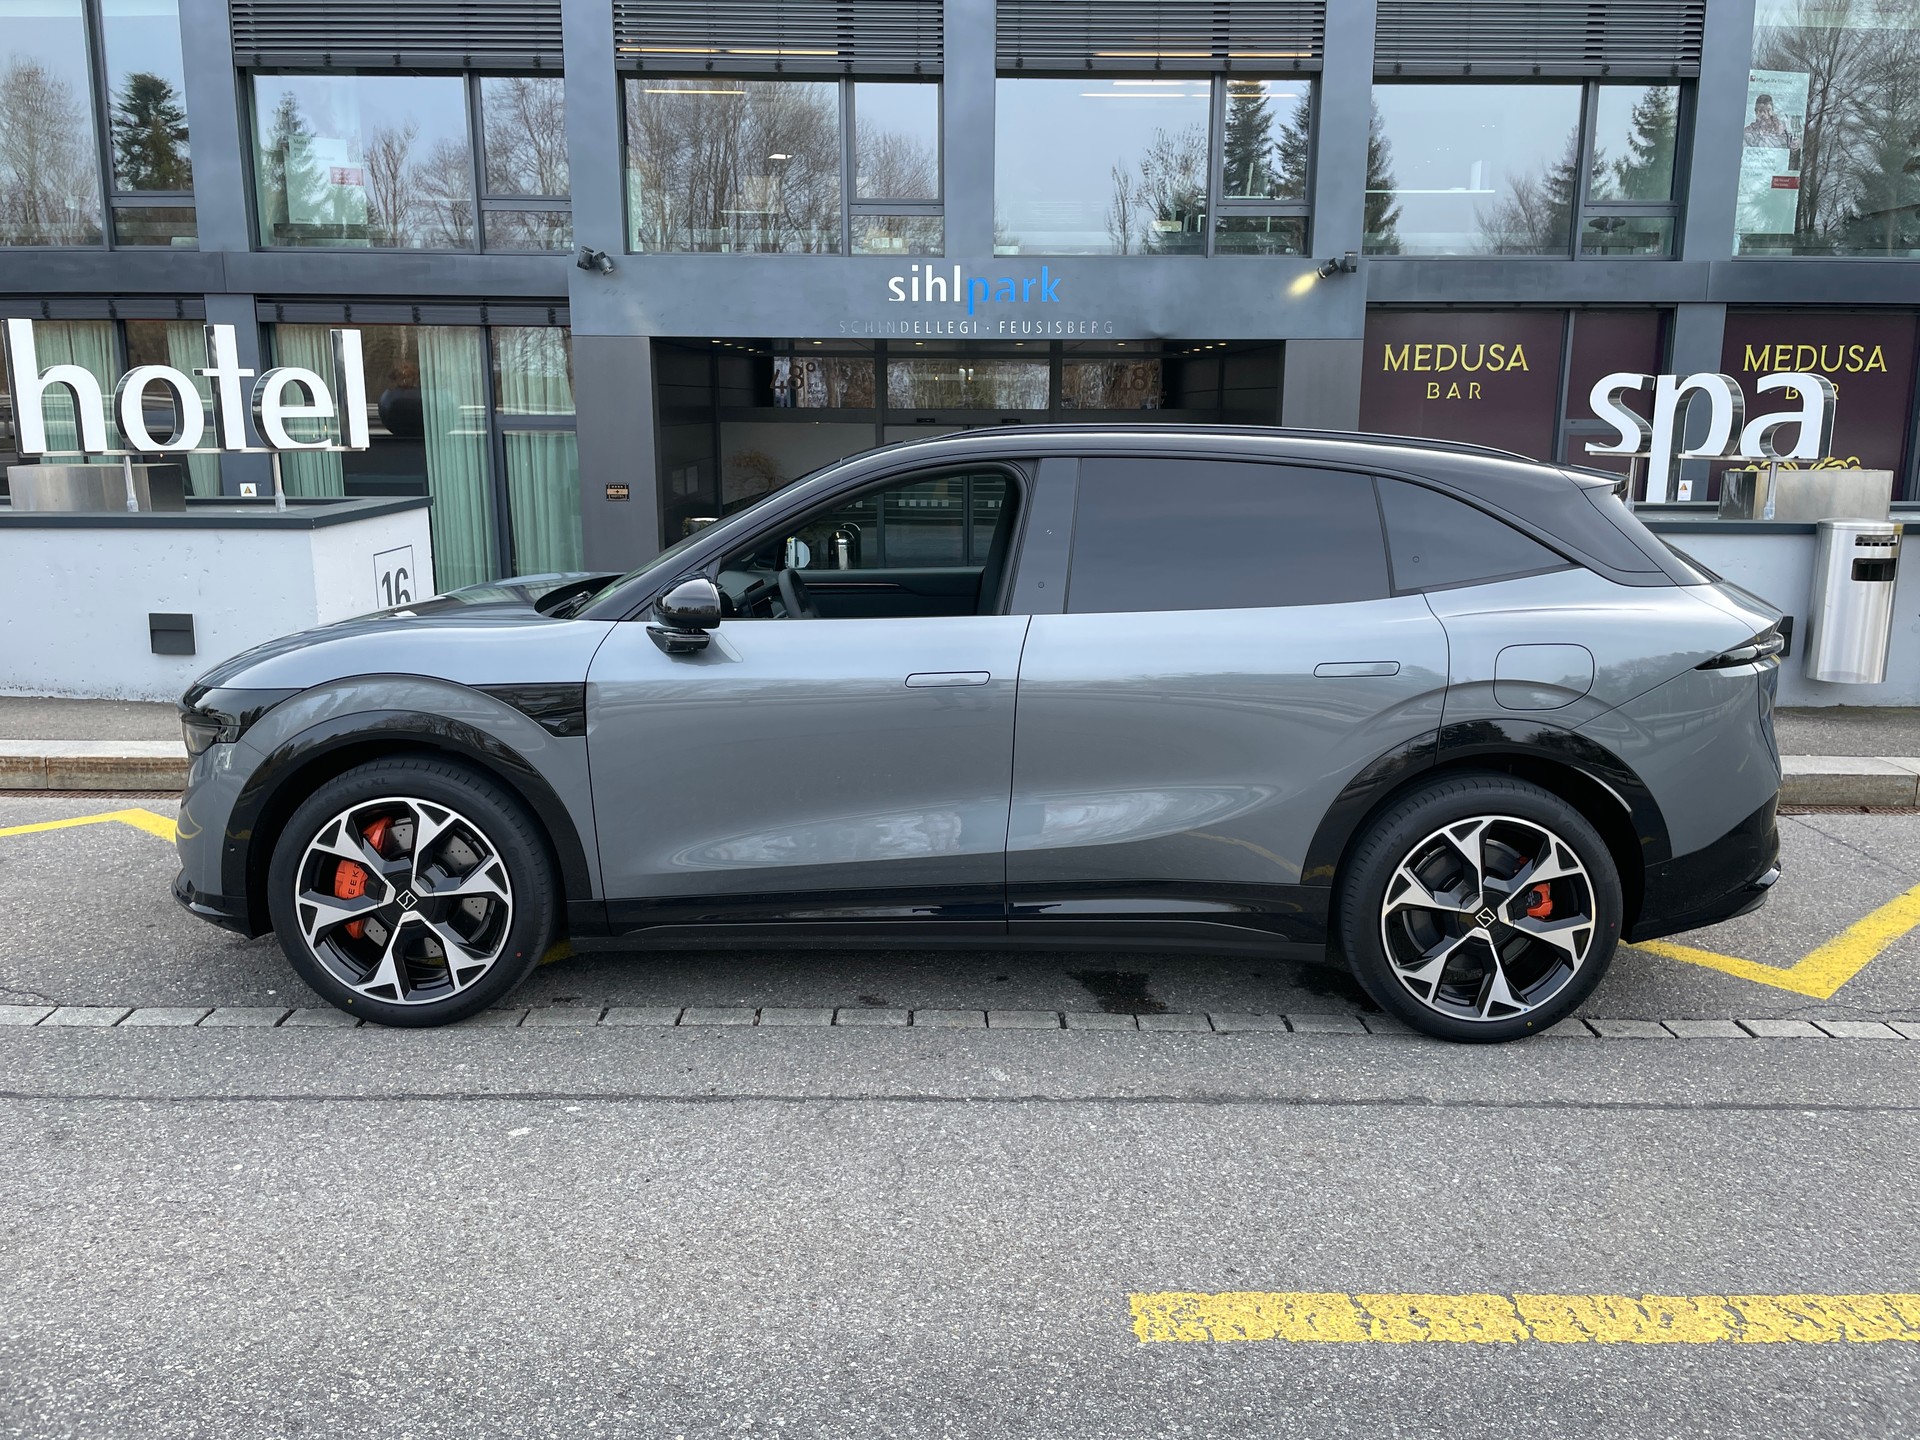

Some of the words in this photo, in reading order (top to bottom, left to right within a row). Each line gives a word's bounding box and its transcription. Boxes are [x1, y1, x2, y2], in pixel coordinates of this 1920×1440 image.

[888, 264, 1062, 316] sihlpark
[839, 320, 978, 334] SCHINDELLEGI
[999, 320, 1113, 334] FEUSISBERG
[1382, 343, 1529, 372] MEDUSA
[1743, 344, 1887, 372] MEDUSA
[2, 318, 370, 454] hotel
[1426, 382, 1482, 400] BAR
[1785, 383, 1839, 400] BR
[1584, 372, 1838, 504] spa
[381, 567, 412, 607] 16
[347, 863, 360, 898] EEK
